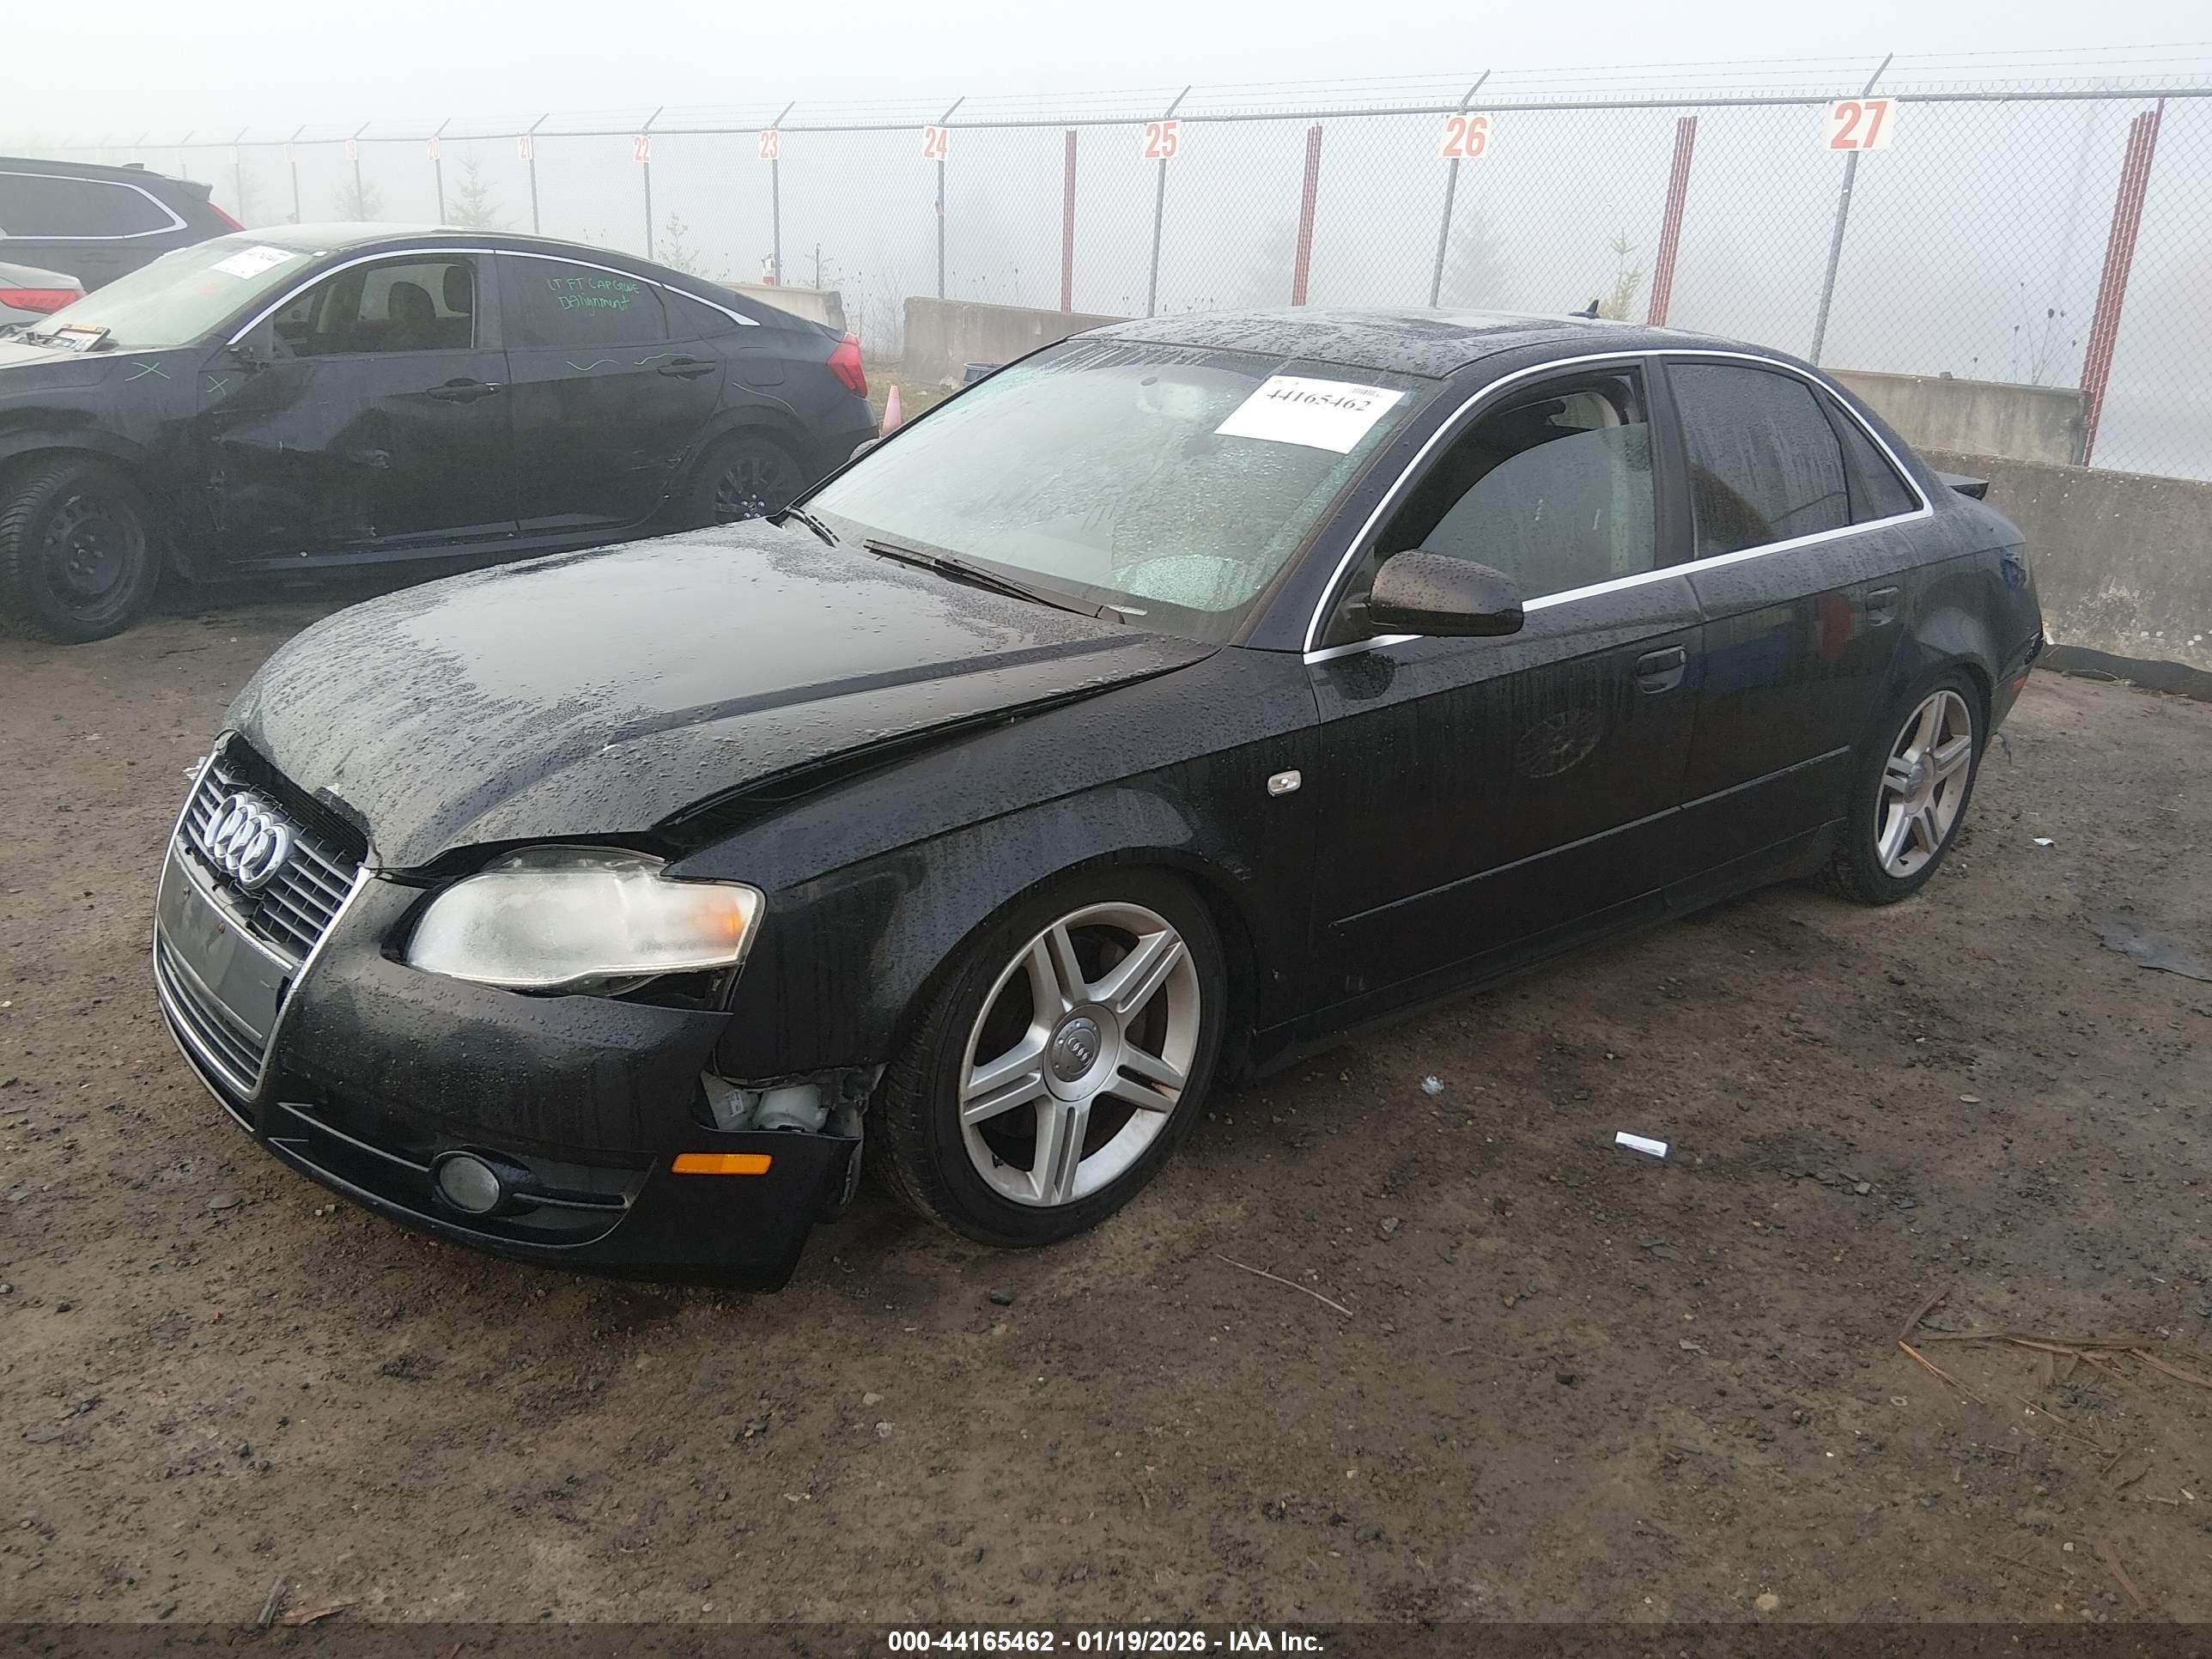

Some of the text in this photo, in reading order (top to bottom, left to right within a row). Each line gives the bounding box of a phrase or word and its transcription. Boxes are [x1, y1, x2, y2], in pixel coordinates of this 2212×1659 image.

[1443, 117, 1487, 157] 26
[1831, 100, 1888, 149] 27
[635, 136, 650, 161] 22
[760, 131, 779, 159] 23
[923, 128, 947, 158] 24
[1145, 123, 1177, 158] 25
[567, 277, 584, 290] FT
[1266, 388, 1372, 411] 44165462
